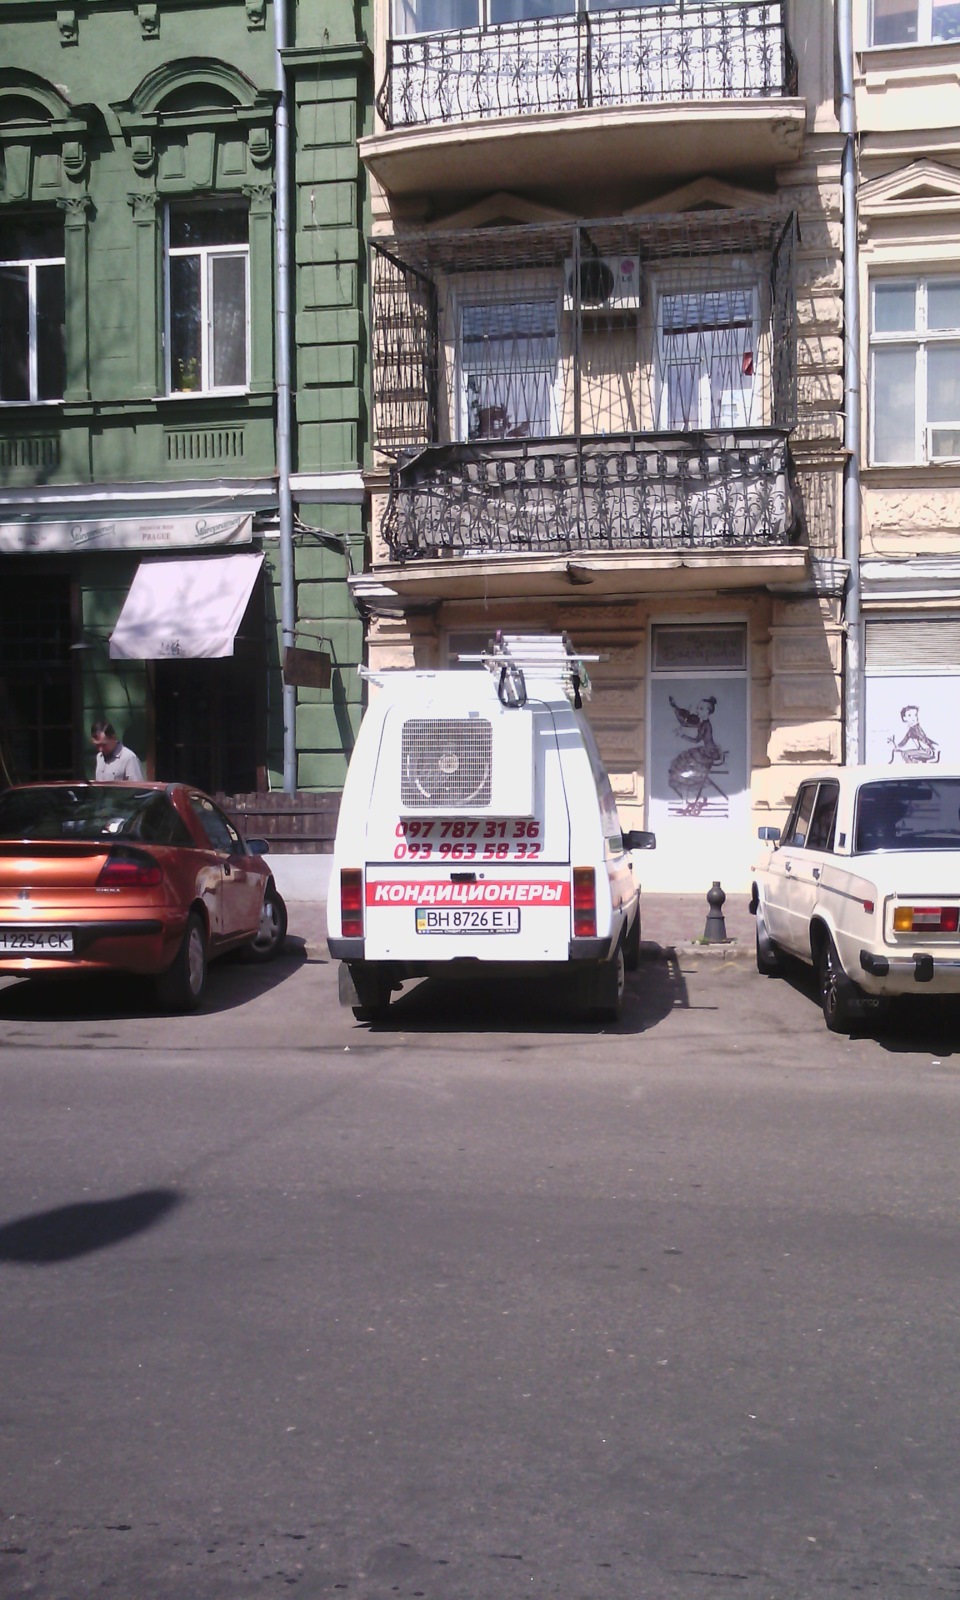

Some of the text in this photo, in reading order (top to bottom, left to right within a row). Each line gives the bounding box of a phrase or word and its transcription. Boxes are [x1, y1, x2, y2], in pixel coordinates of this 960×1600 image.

[142, 532, 171, 541] PRAGUE
[395, 821, 540, 838] 097 787 31 36
[393, 842, 542, 860] 093 963 58 32
[374, 883, 563, 904] КОНДИЦИОНЕРЫ
[427, 911, 450, 927] BH
[453, 911, 489, 926] 8726
[10, 934, 44, 948] 2254
[47, 934, 69, 948] CK
